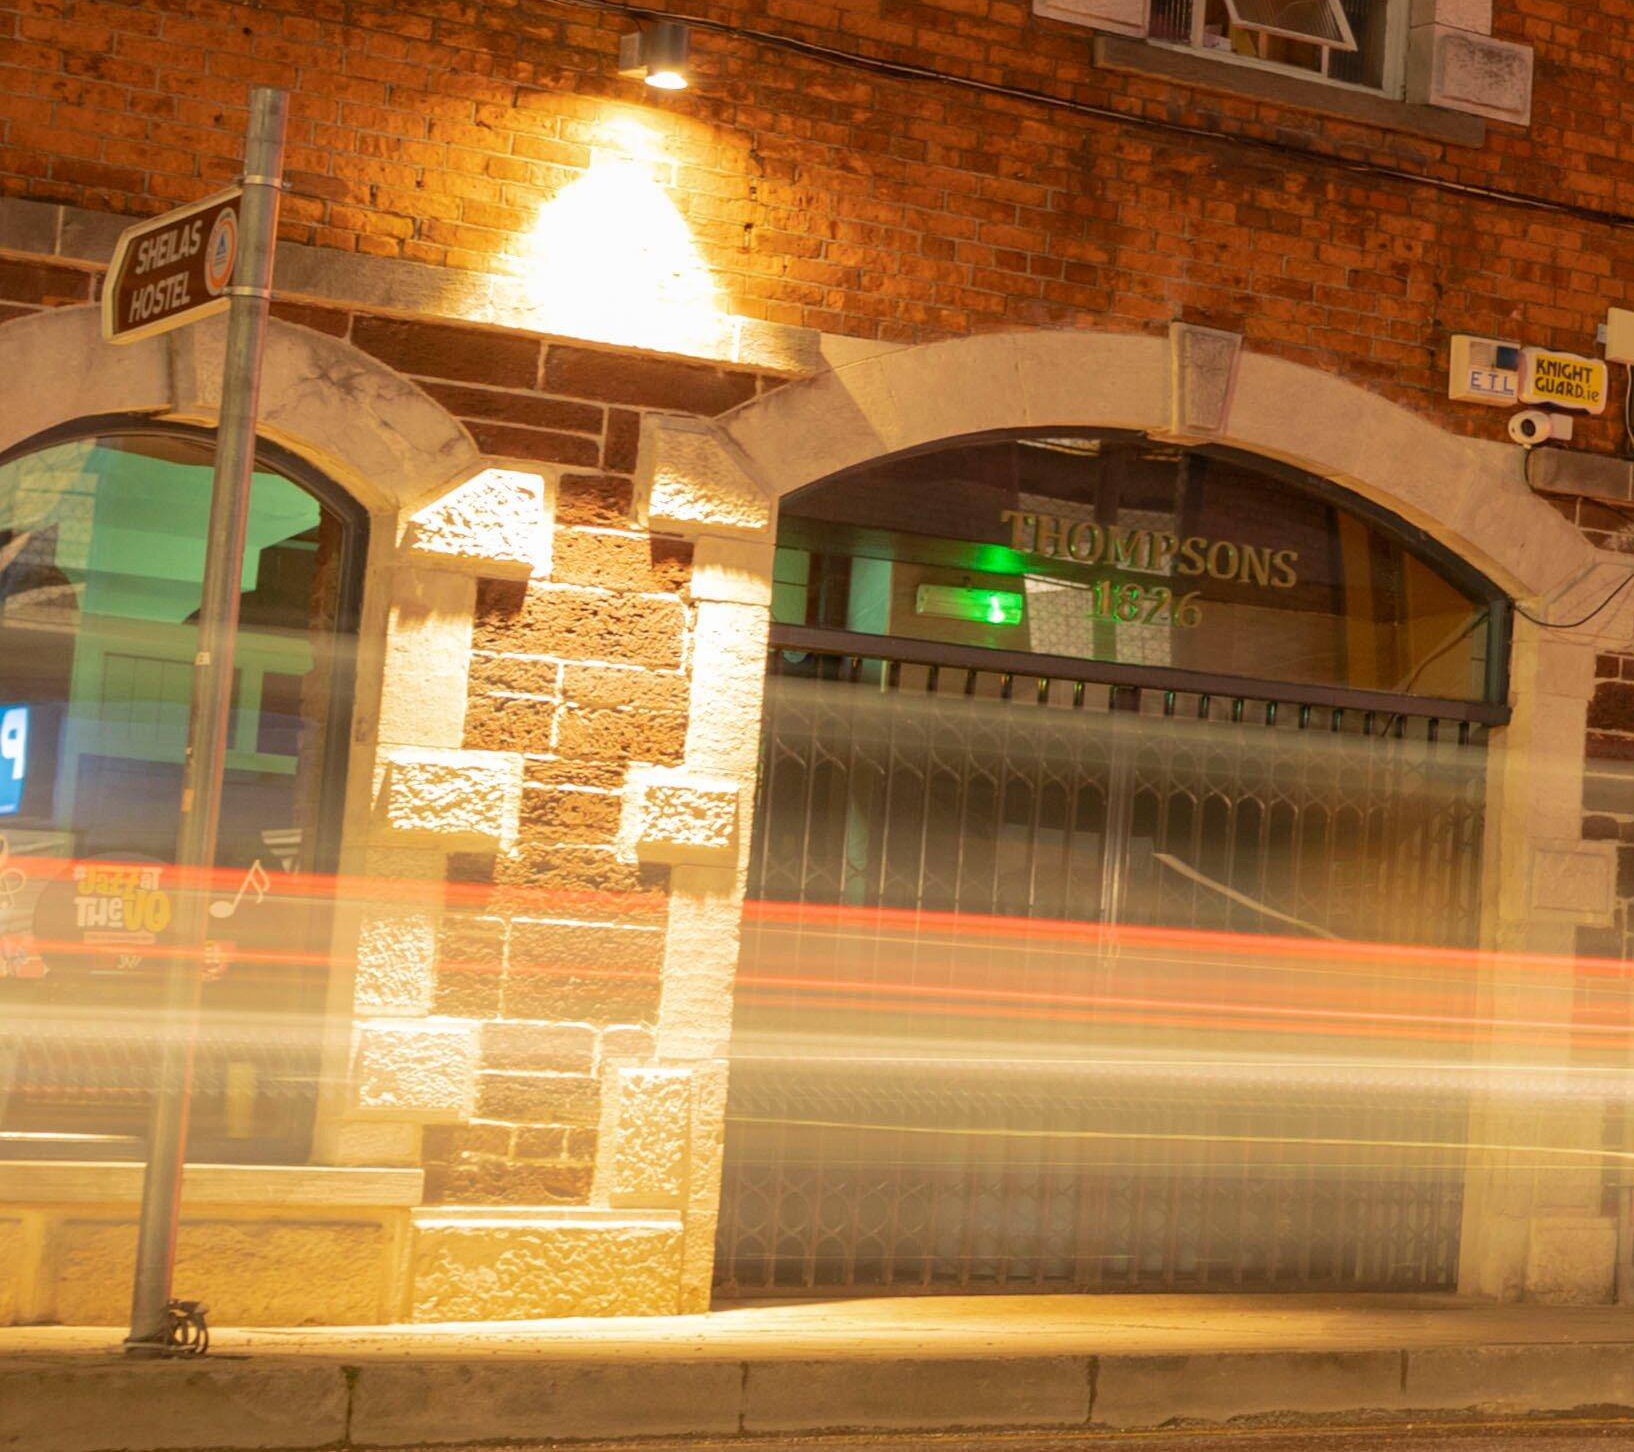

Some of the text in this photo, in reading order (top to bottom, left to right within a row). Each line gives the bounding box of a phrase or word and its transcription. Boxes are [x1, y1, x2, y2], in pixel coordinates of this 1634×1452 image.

[135, 220, 203, 275] SHEILAS
[128, 271, 191, 323] HOSTEL
[1470, 370, 1515, 393] ETL
[1534, 375, 1600, 403] GUARD.ie
[1535, 358, 1593, 384] KNIGHT
[1001, 510, 1298, 589] THOMPSONS
[1095, 580, 1203, 629] 1826
